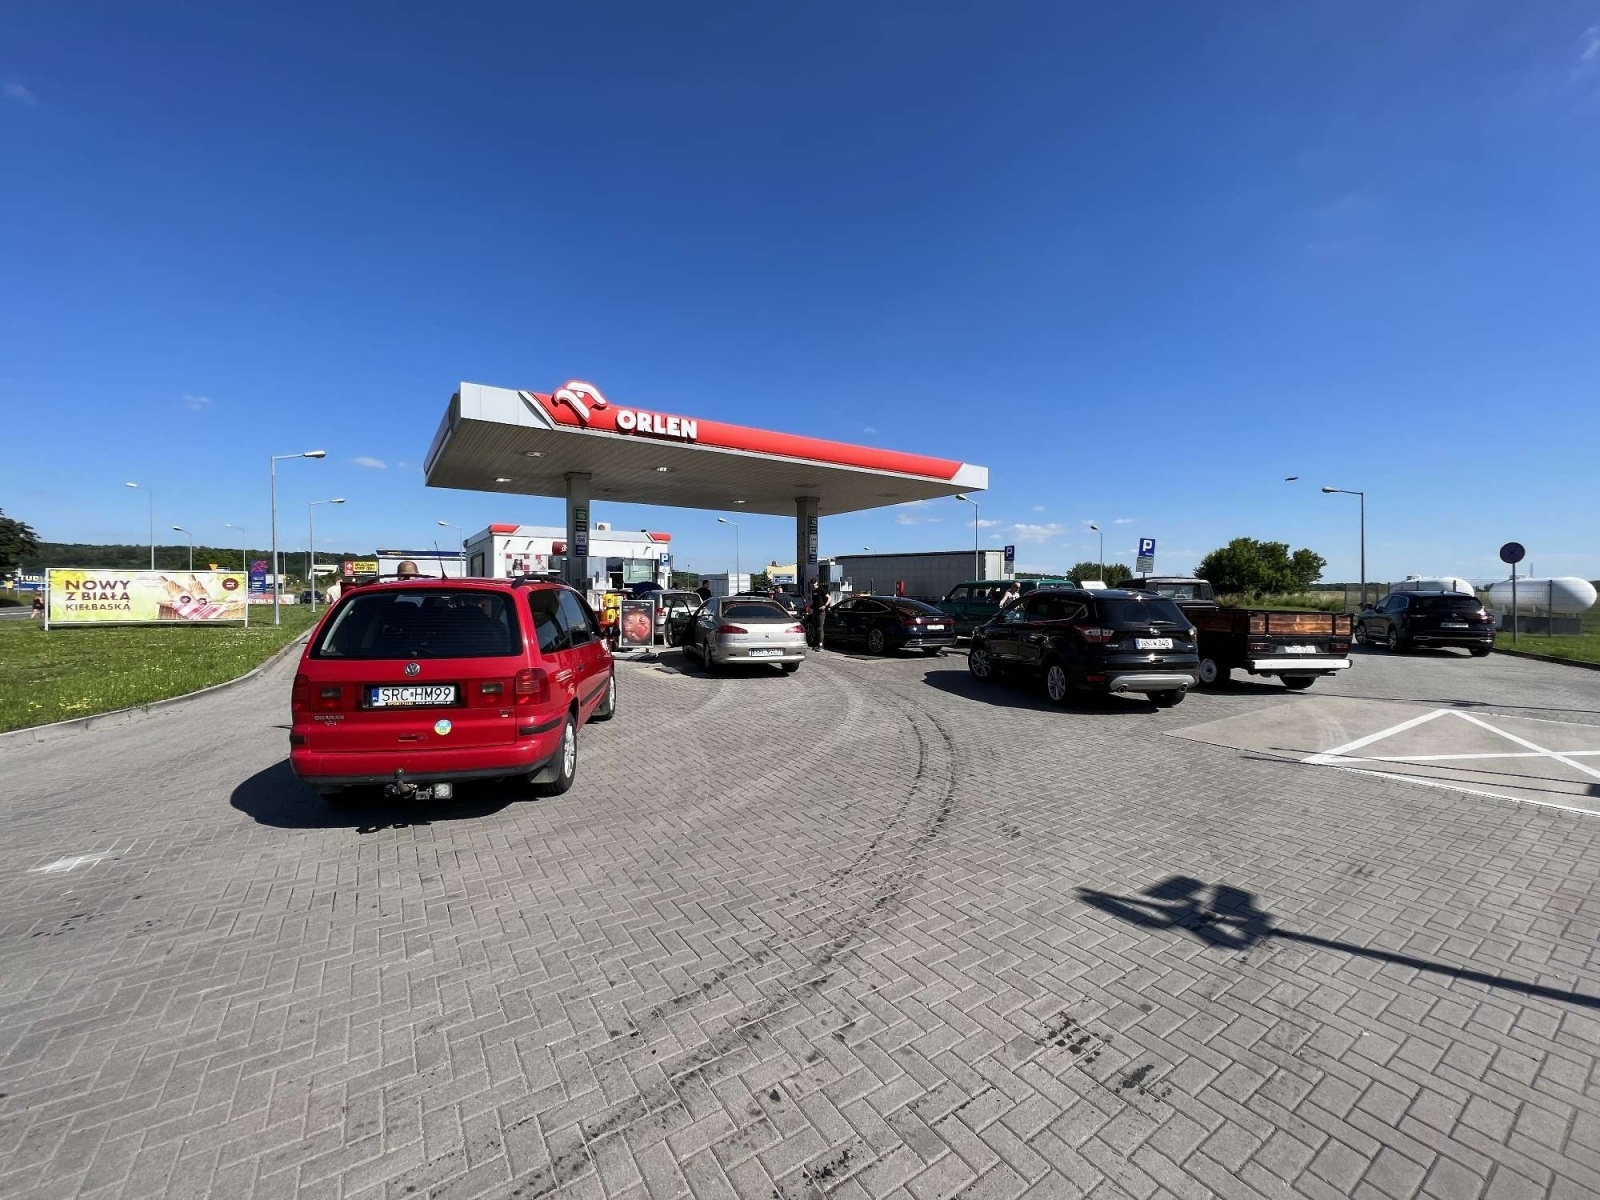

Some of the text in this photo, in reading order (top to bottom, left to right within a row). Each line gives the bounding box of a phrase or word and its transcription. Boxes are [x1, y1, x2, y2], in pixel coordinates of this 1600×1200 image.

[616, 409, 697, 439] ORLEN
[1143, 540, 1153, 551] P
[1006, 547, 1012, 557] P
[662, 554, 669, 562] P
[65, 580, 130, 591] NOWY
[65, 592, 130, 603] Z BIAŁĄ
[65, 603, 131, 612] KIEŁBASKĄ
[382, 687, 451, 702] SRC HM99
